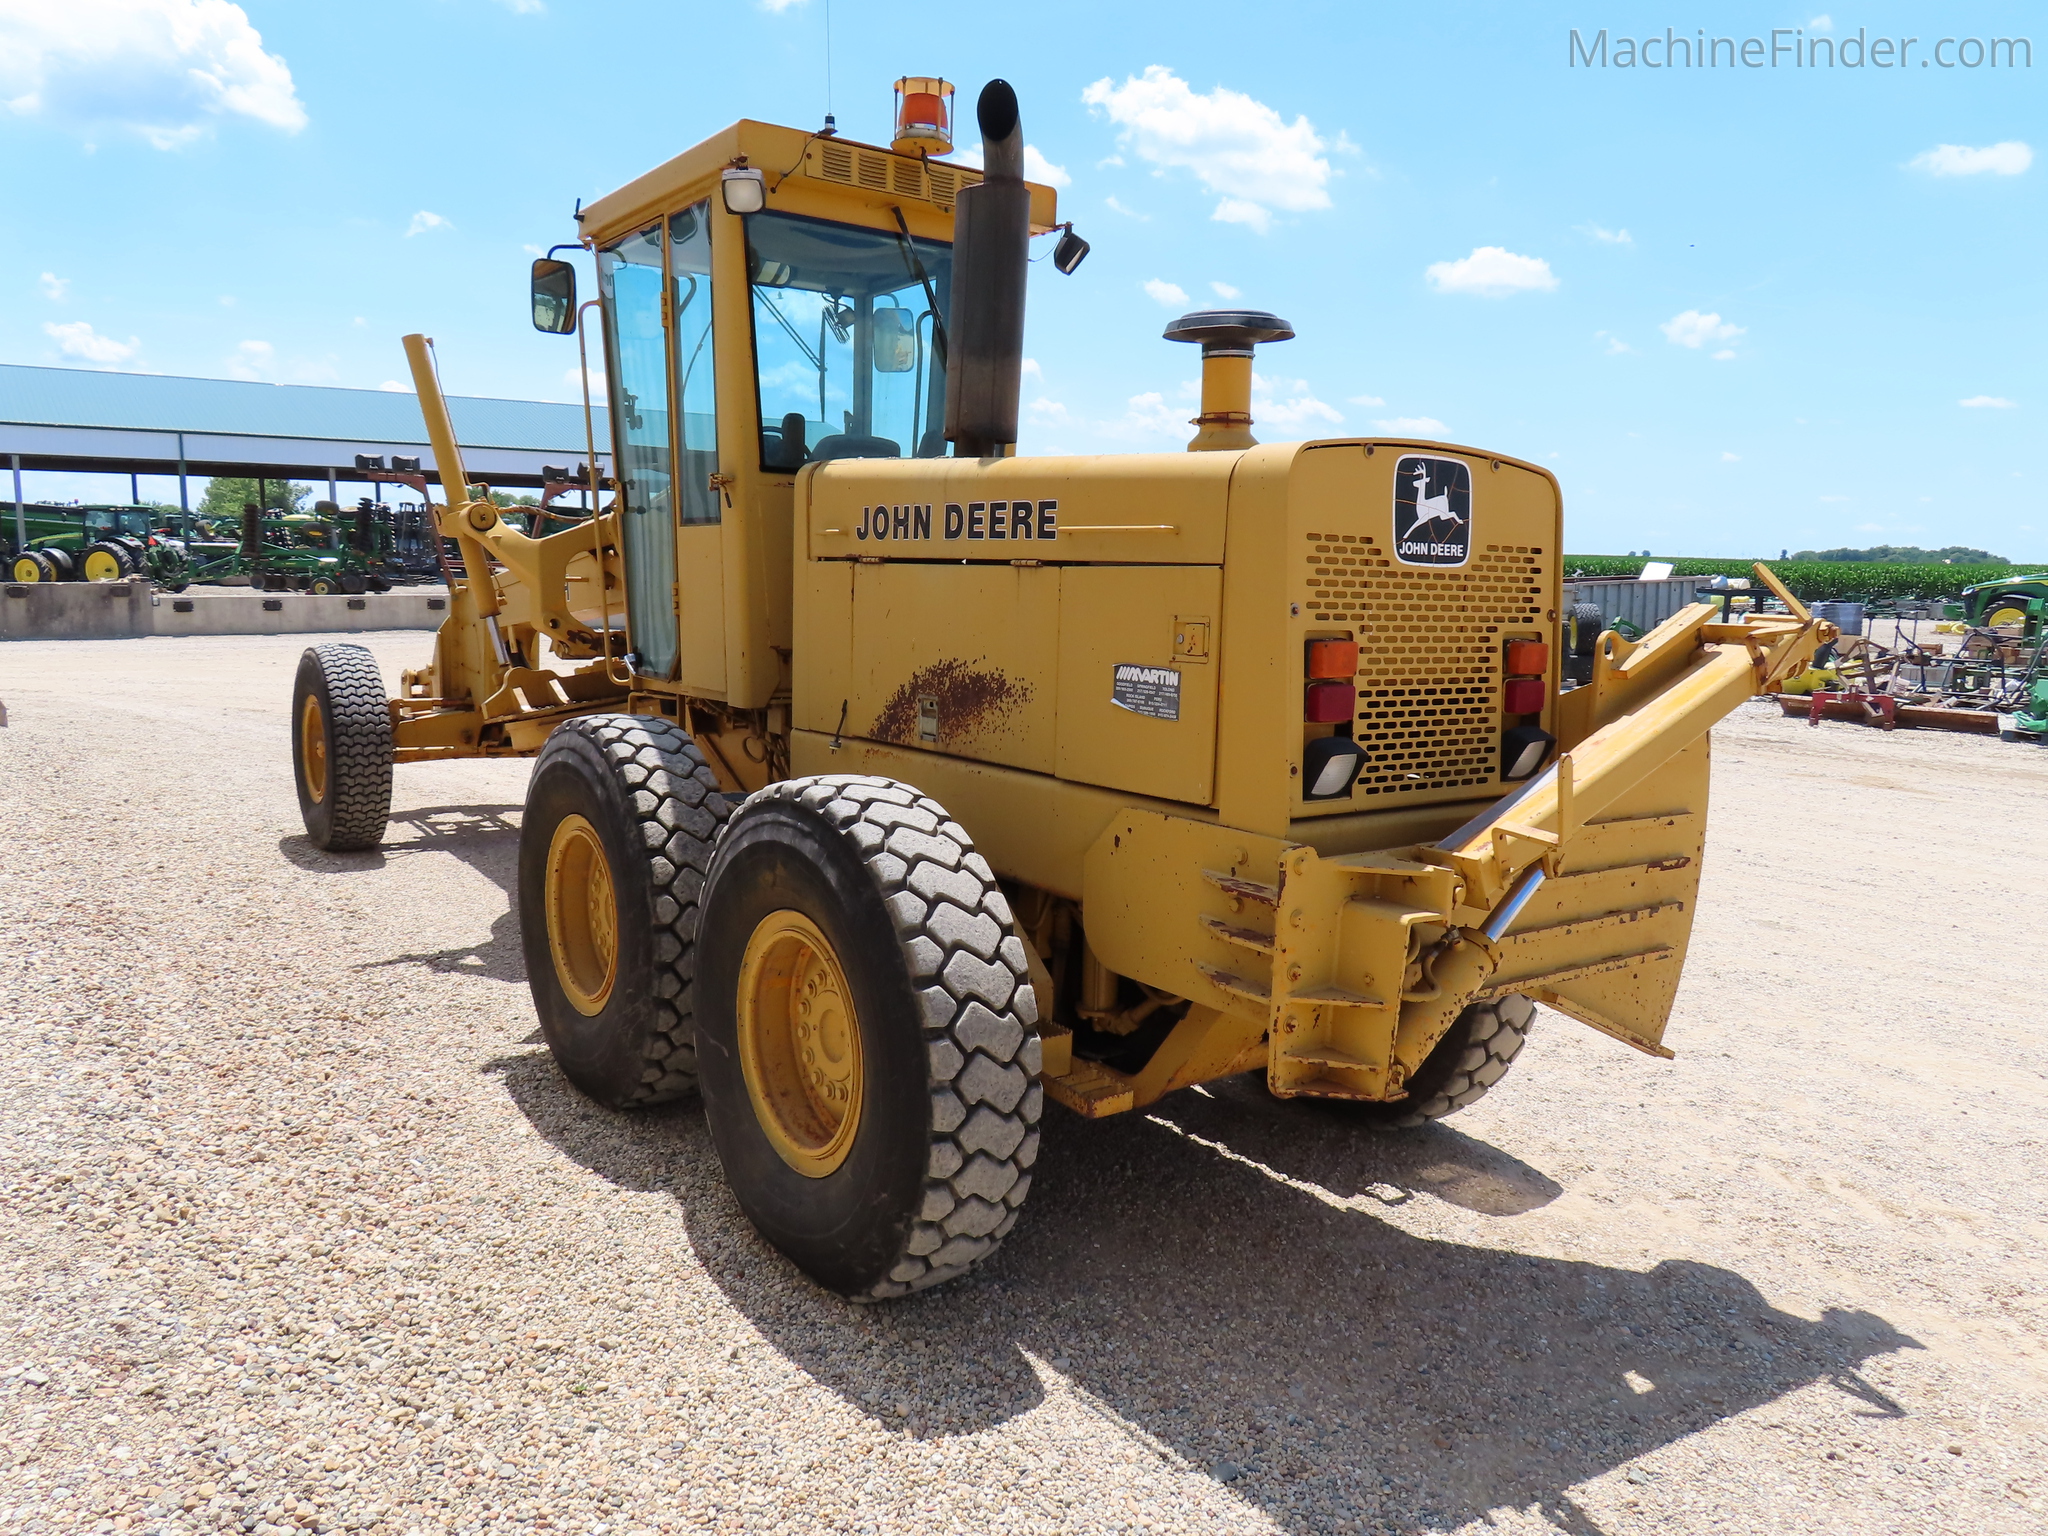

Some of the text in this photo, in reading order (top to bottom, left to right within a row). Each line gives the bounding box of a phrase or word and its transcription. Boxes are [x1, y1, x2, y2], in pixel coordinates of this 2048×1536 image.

[856, 499, 1059, 542] JOHN DEERE
[1399, 541, 1464, 557] JOHN DEERE
